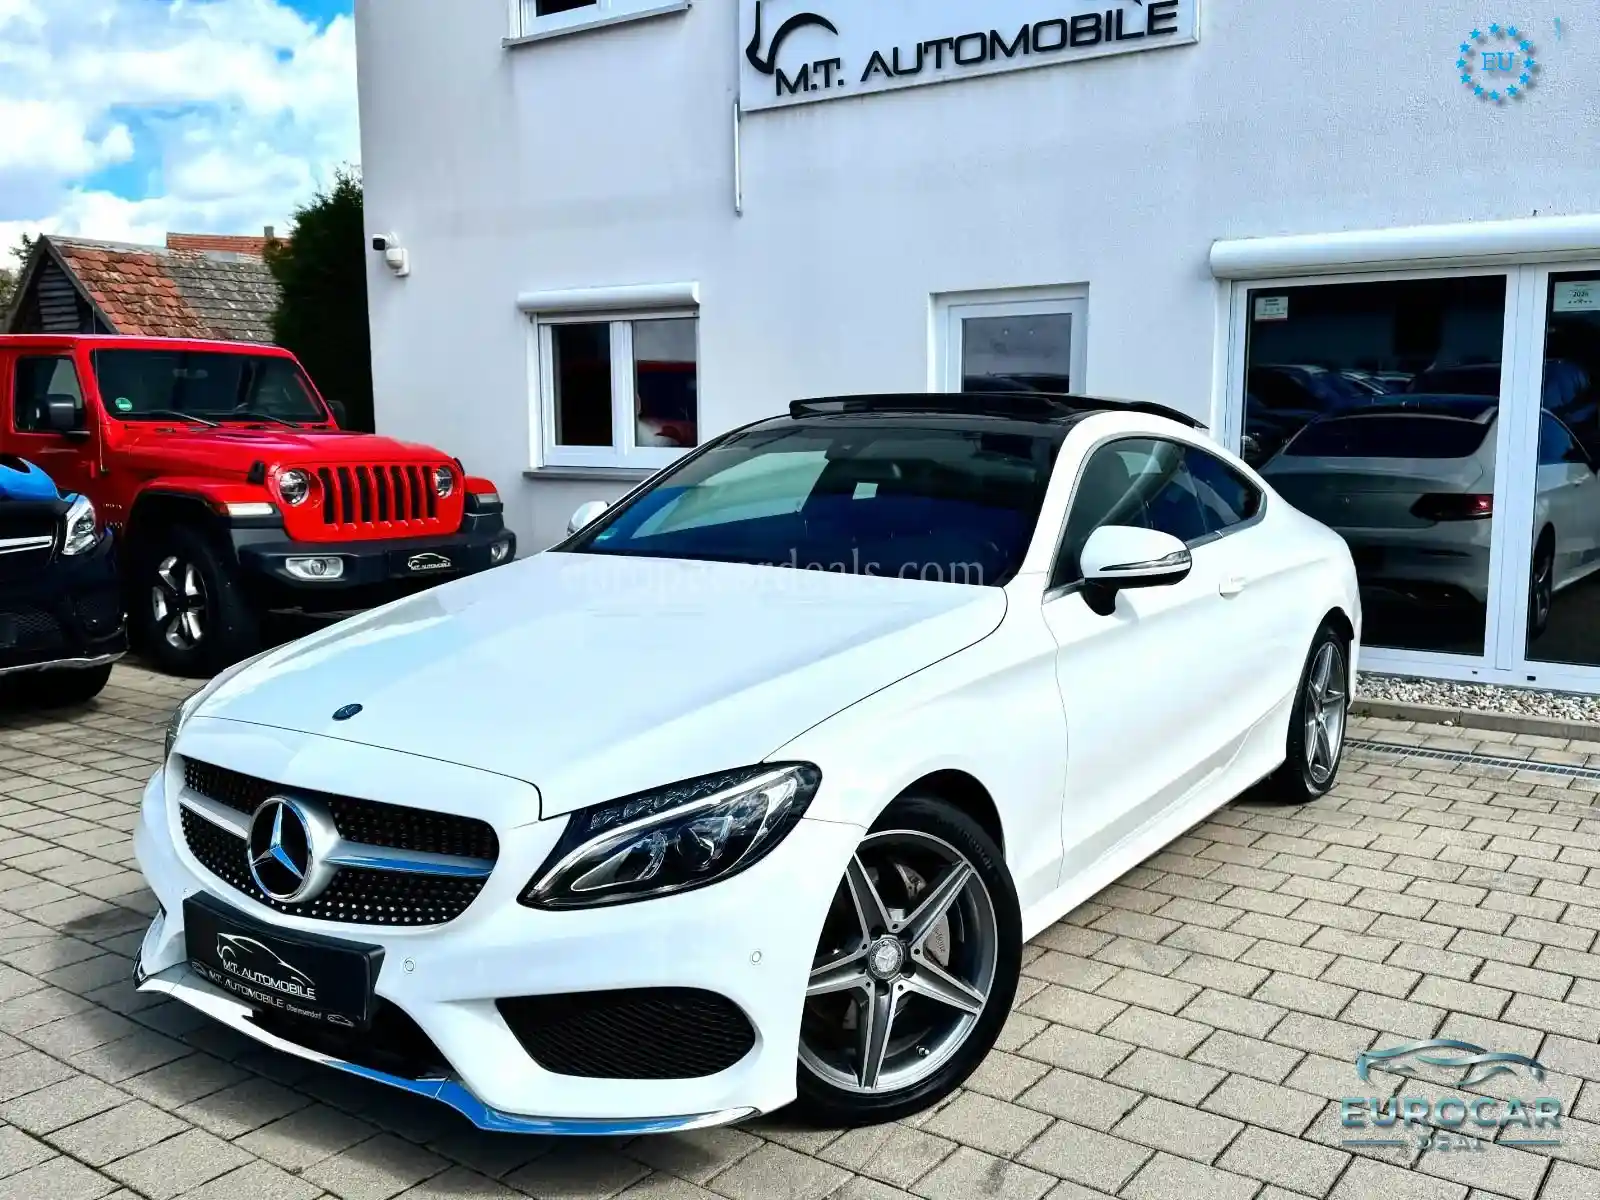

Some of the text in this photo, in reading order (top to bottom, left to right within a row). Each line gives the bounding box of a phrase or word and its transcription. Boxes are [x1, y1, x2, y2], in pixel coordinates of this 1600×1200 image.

[774, 0, 1179, 96] M.T. AUTOMOBILE
[225, 978, 284, 1008] AUTOMOBILE
[241, 968, 316, 999] AUTOMOBILE
